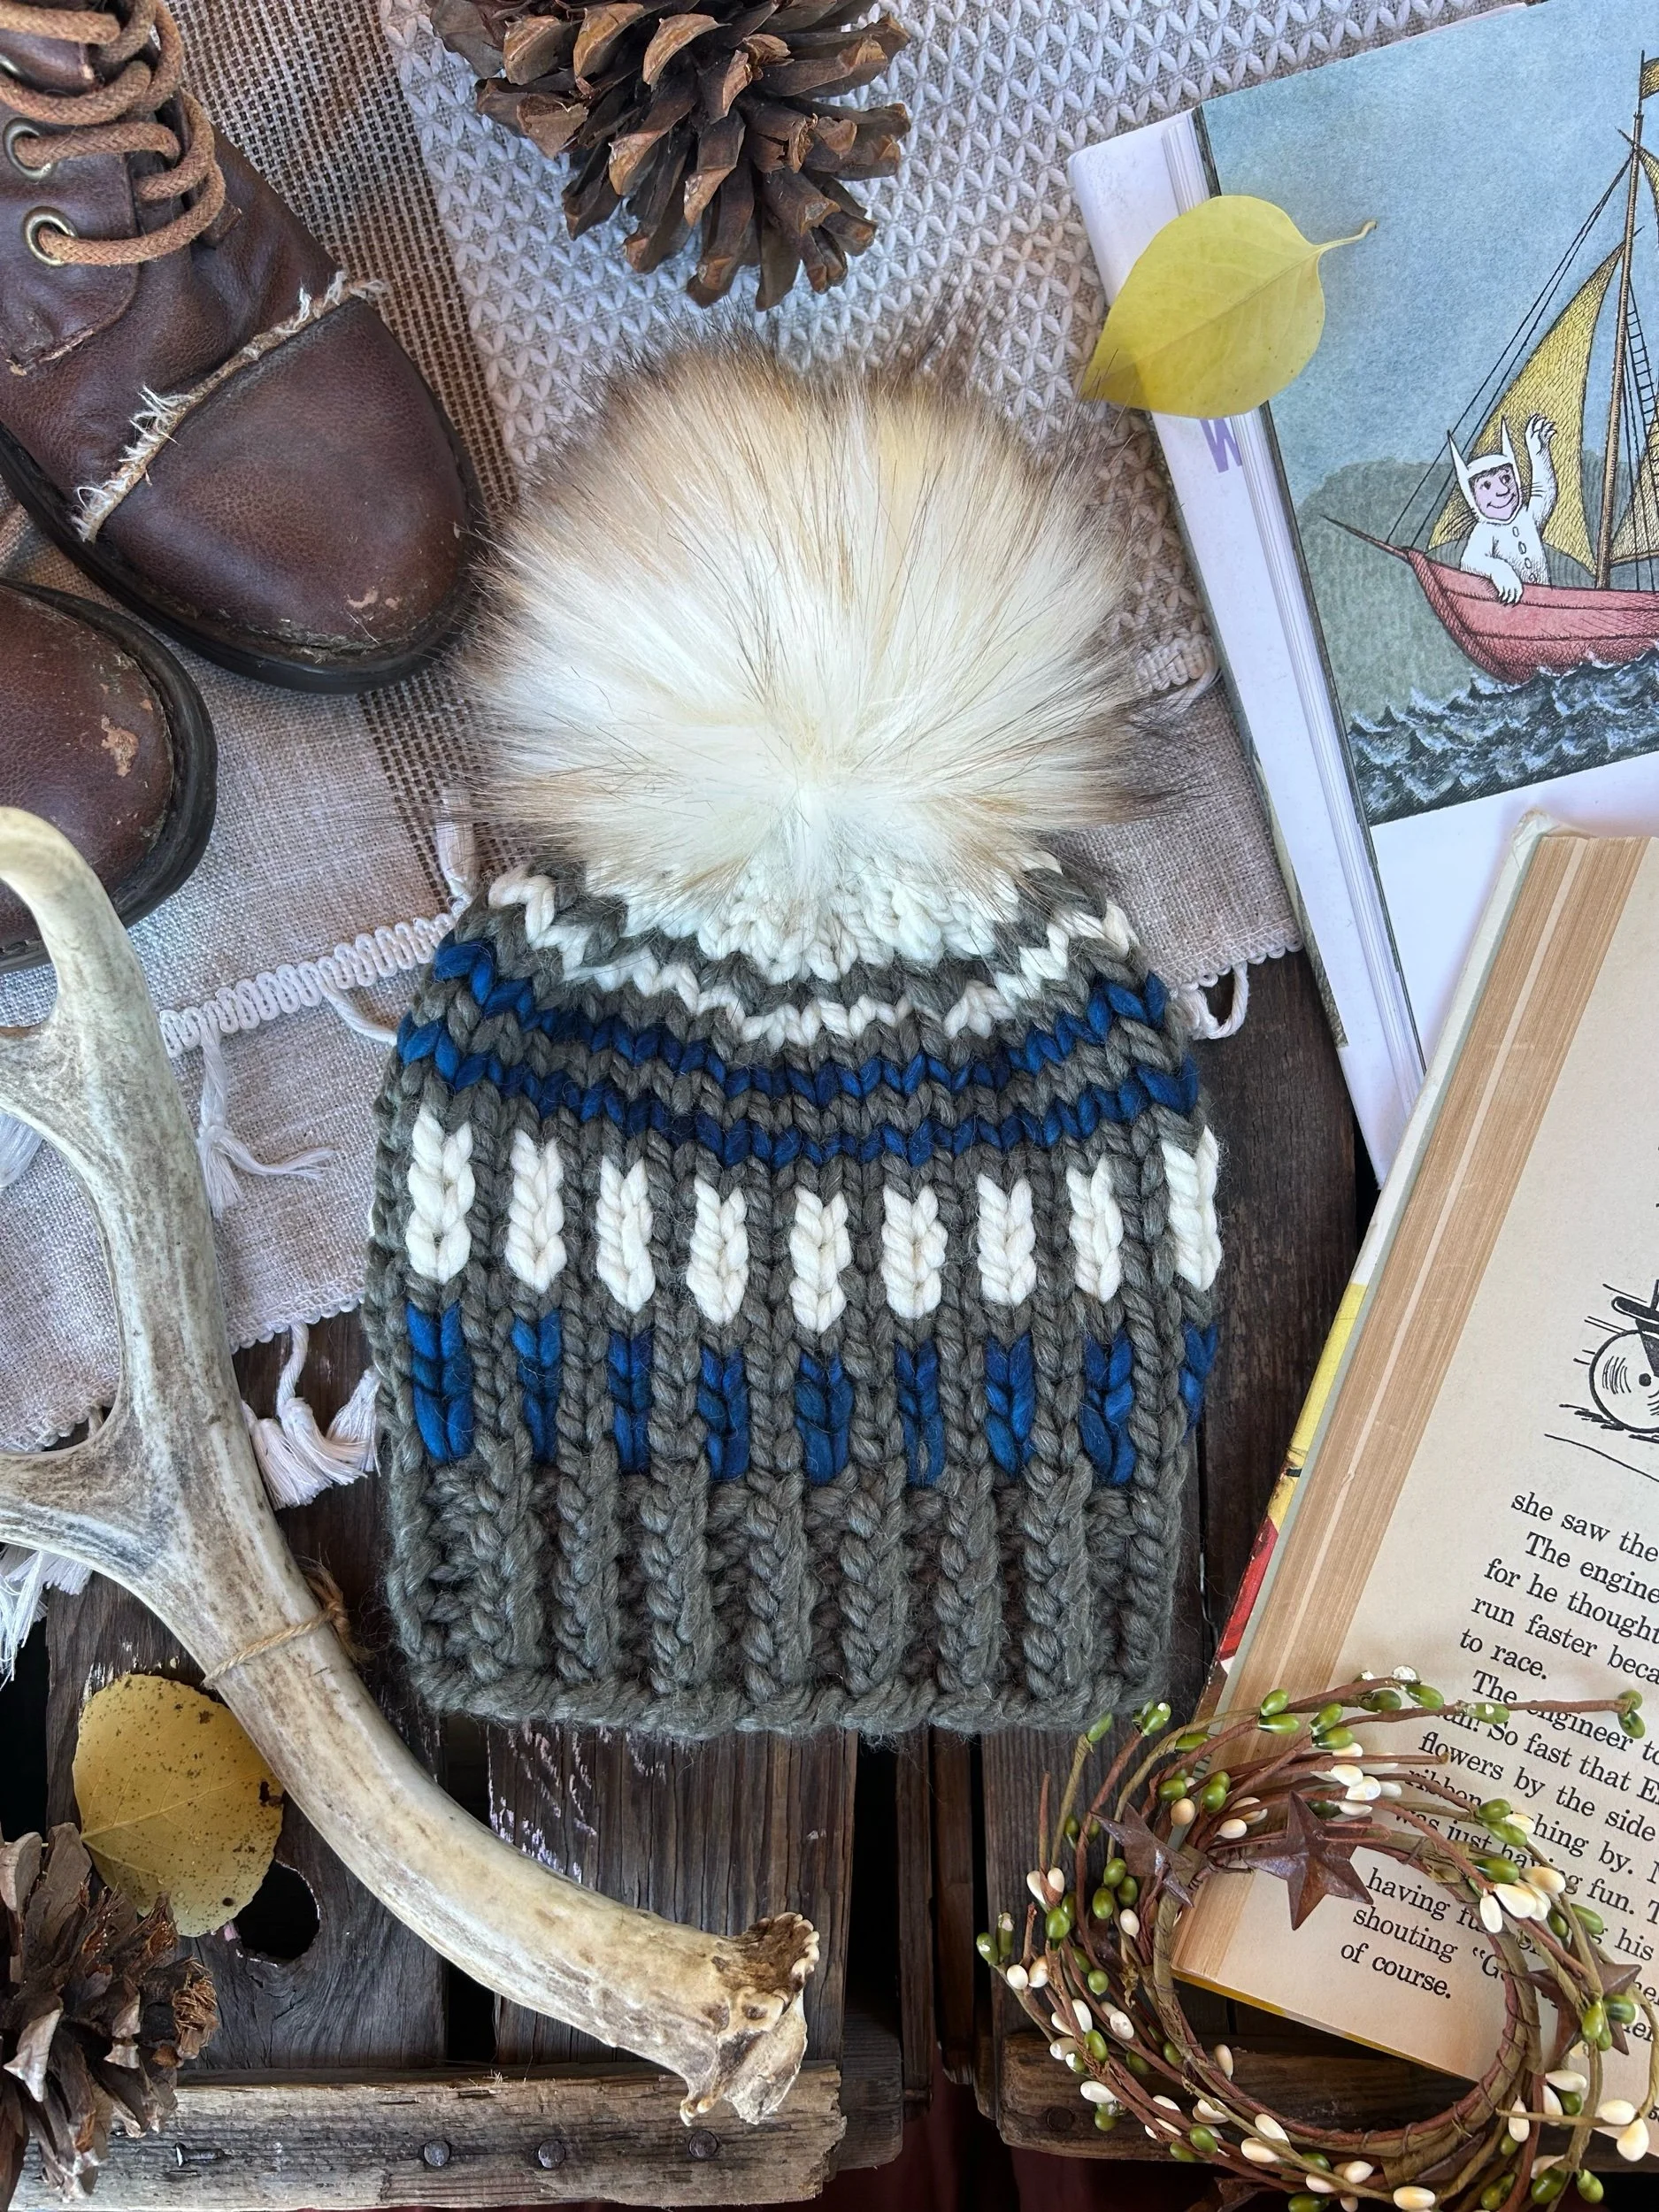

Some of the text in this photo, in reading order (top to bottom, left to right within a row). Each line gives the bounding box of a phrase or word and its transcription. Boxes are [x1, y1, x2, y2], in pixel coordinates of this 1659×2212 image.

[1511, 1492, 1658, 1562] she saw the
[1525, 1532, 1571, 1567] The
[1484, 1558, 1520, 1587] for
[1526, 1573, 1557, 1602] he
[1471, 1598, 1515, 1626] run
[1525, 1614, 1597, 1657] faster
[1460, 1629, 1547, 1680] to race.
[1472, 1670, 1517, 1704] The
[1486, 1720, 1518, 1746] So
[1524, 1733, 1572, 1768] fast
[1579, 1755, 1632, 1791] that
[1418, 1732, 1655, 1841] flowers by the side
[1598, 1840, 1633, 1875] by.
[1366, 1867, 1450, 1921] having
[1586, 1878, 1634, 1915] fun.
[1353, 1906, 1458, 1963] shouting
[1614, 1927, 1654, 1961] his
[1340, 1943, 1451, 1999] of course.
